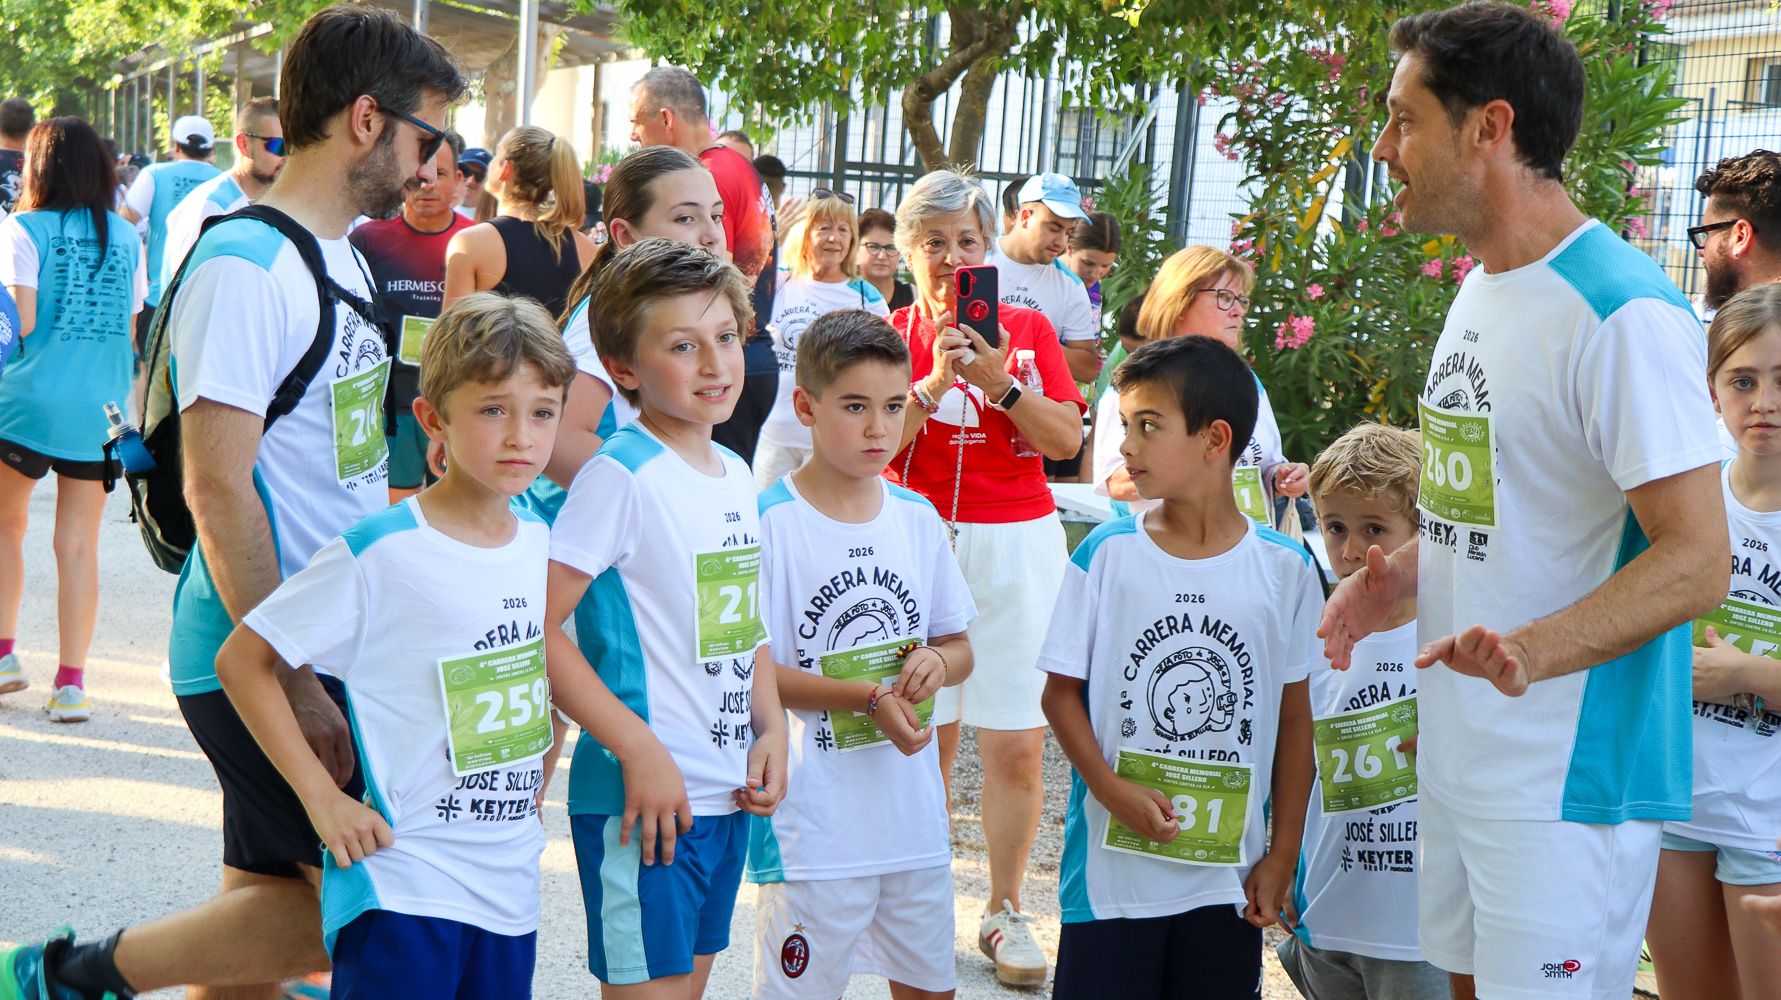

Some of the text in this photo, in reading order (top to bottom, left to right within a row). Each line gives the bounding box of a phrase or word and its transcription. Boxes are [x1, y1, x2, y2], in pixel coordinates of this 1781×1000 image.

[387, 280, 437, 292] HERMES
[1463, 329, 1480, 343] 2026
[1427, 351, 1466, 402] ARRERA
[1425, 440, 1473, 492] 260
[848, 546, 874, 558] 2026
[1742, 537, 1768, 552] 2026
[502, 597, 528, 609] 2026
[798, 566, 868, 640] CARRERA
[873, 566, 921, 635] MEMORI
[1175, 593, 1206, 604] 2026
[1747, 616, 1774, 628] SILLERO
[860, 650, 889, 660] CARRERA
[1123, 612, 1194, 682] CARRERA
[1200, 614, 1255, 710] MEMORIAL
[1376, 662, 1404, 672] 2026
[475, 678, 545, 734] 259
[719, 685, 745, 714] JOSÉ
[1335, 719, 1357, 729] CARRERA
[1356, 711, 1389, 725] MEMORIAL
[1352, 722, 1377, 733] SILLERO
[1331, 735, 1409, 783] 261
[1159, 763, 1189, 774] CARRERA
[1189, 768, 1222, 778] MEMORIAL
[1165, 771, 1208, 784] JOSÉ SILLERO
[469, 798, 529, 818] KEYTER
[1160, 789, 1224, 834] 81
[1344, 816, 1375, 843] JOSÉ
[1357, 849, 1414, 867] KEYTER
